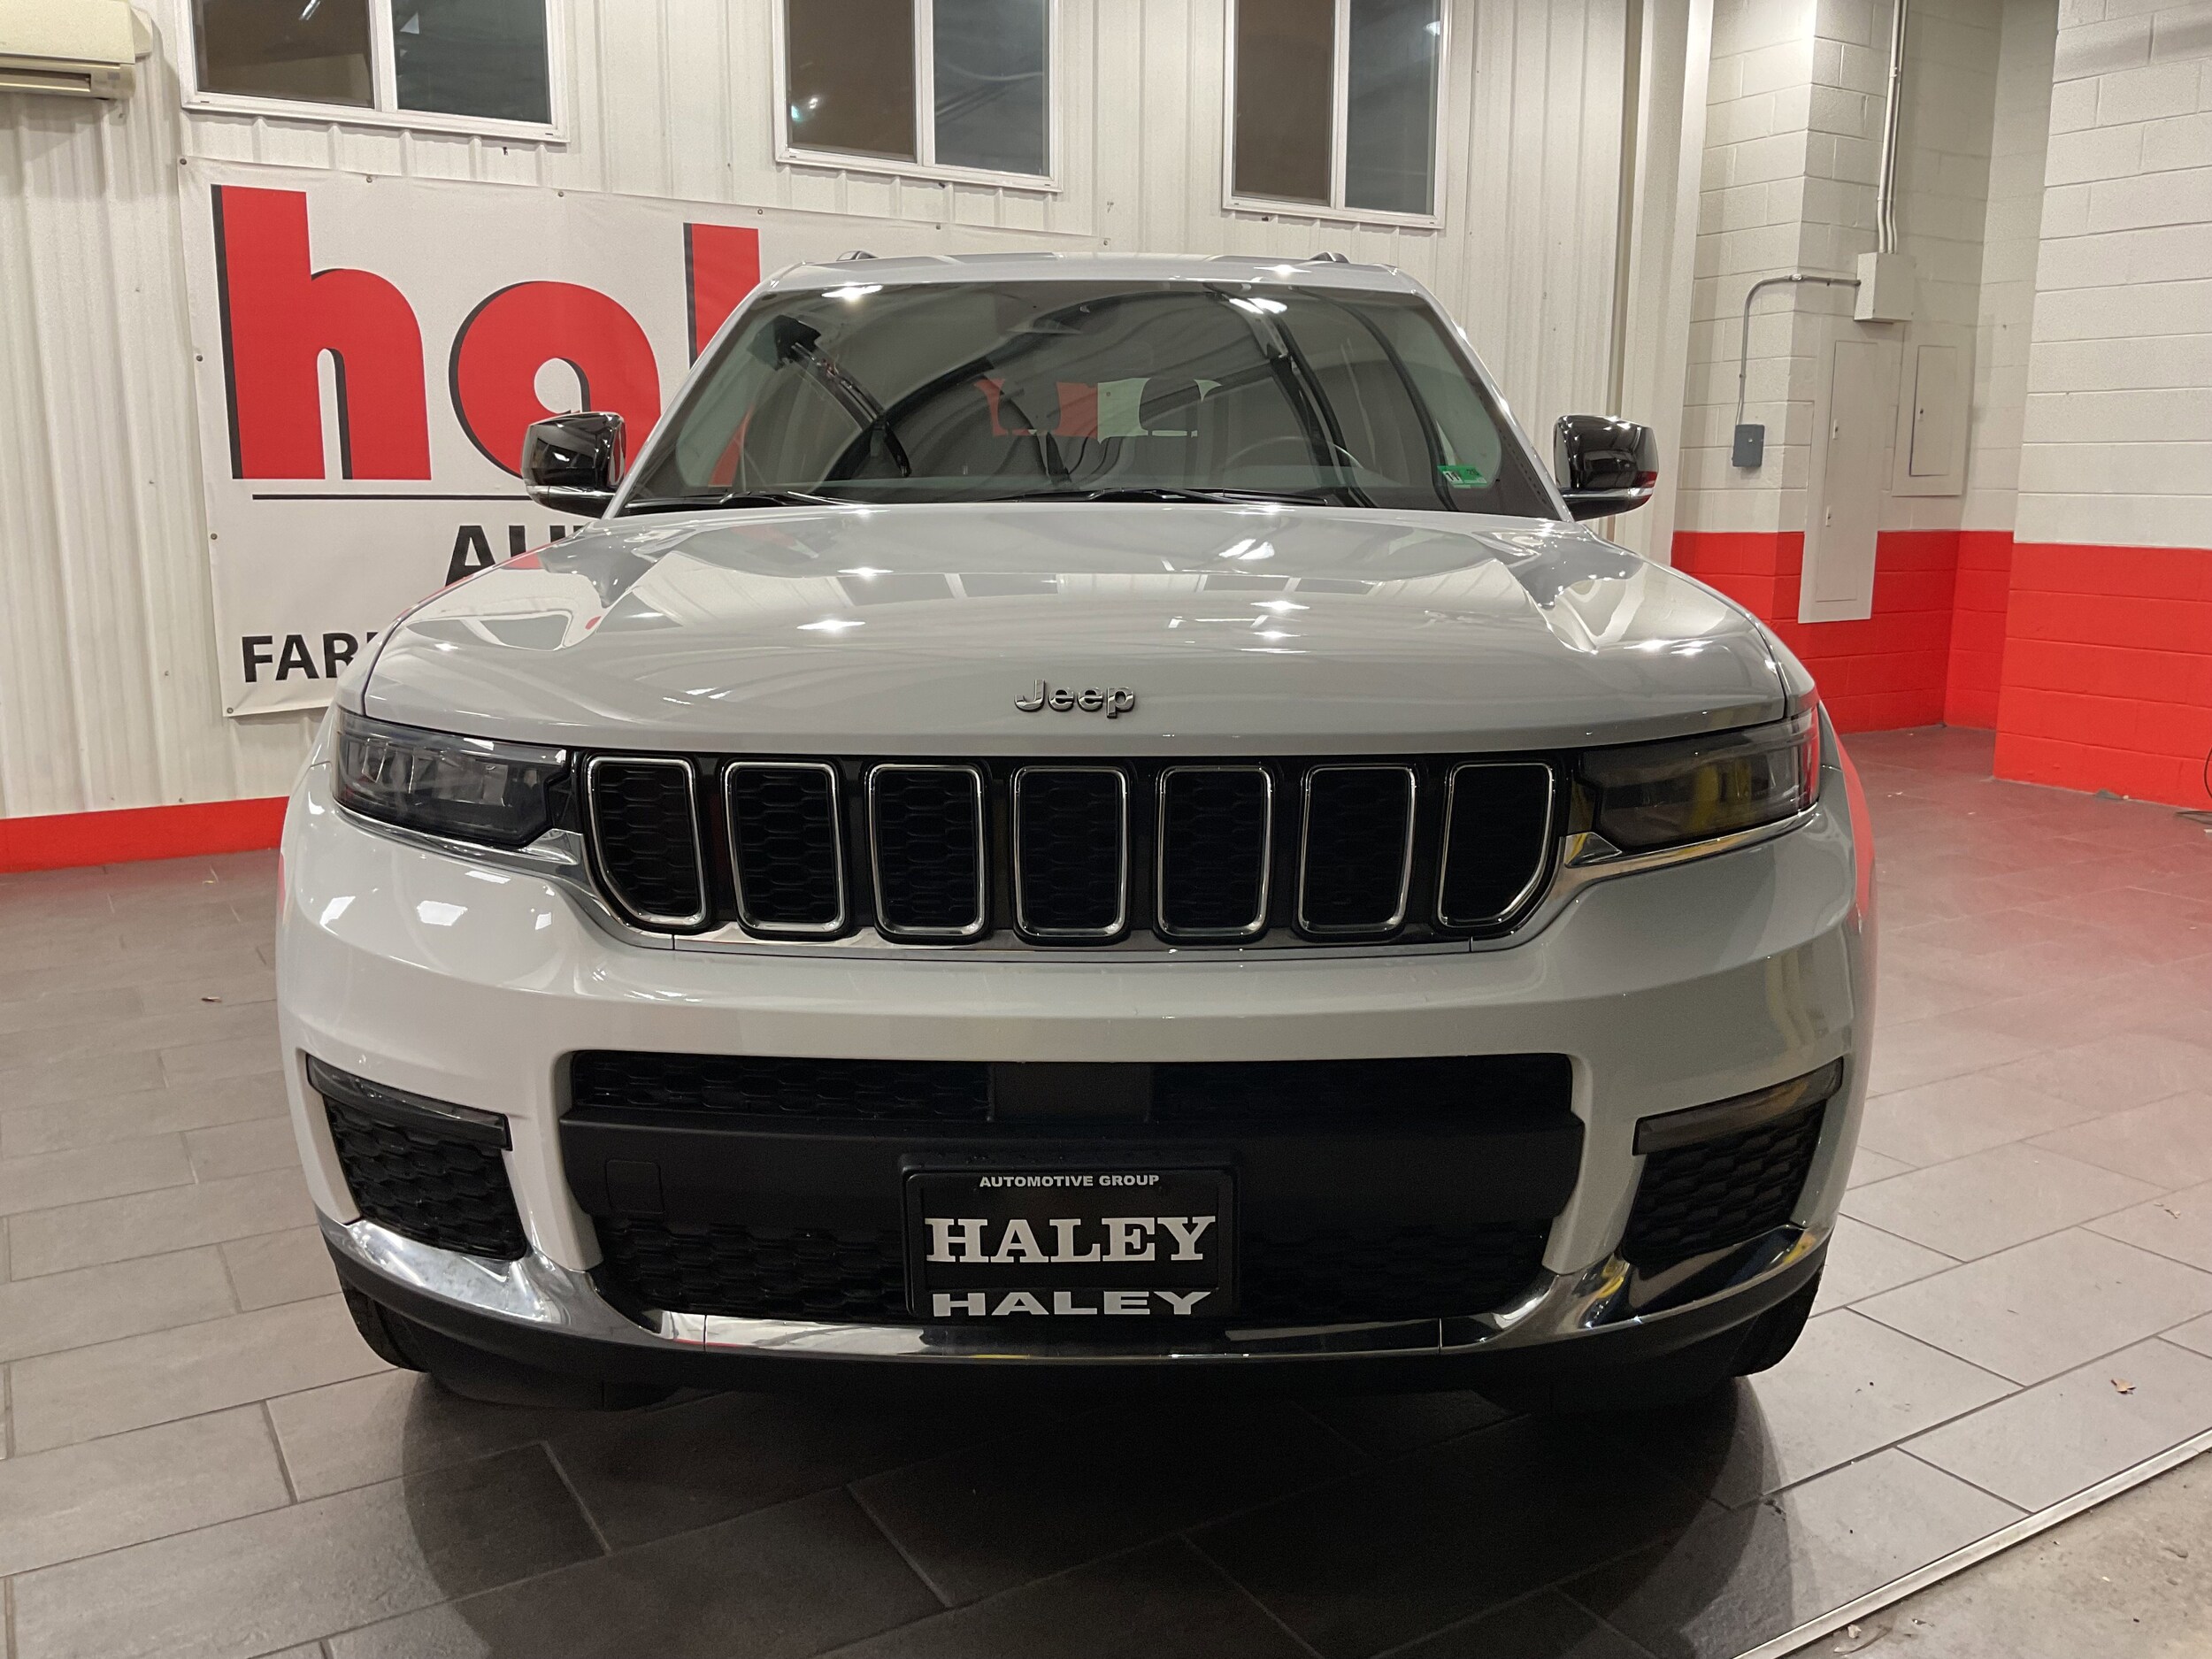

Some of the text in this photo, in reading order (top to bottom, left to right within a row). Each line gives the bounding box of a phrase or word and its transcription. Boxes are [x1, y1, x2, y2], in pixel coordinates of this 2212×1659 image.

[241, 631, 379, 683] FAR
[1014, 679, 1135, 719] Jeep
[979, 1174, 1160, 1187] AUTOMOTIVE GROUP
[925, 1216, 1216, 1263] HALEY
[933, 1291, 1211, 1317] HALEY
